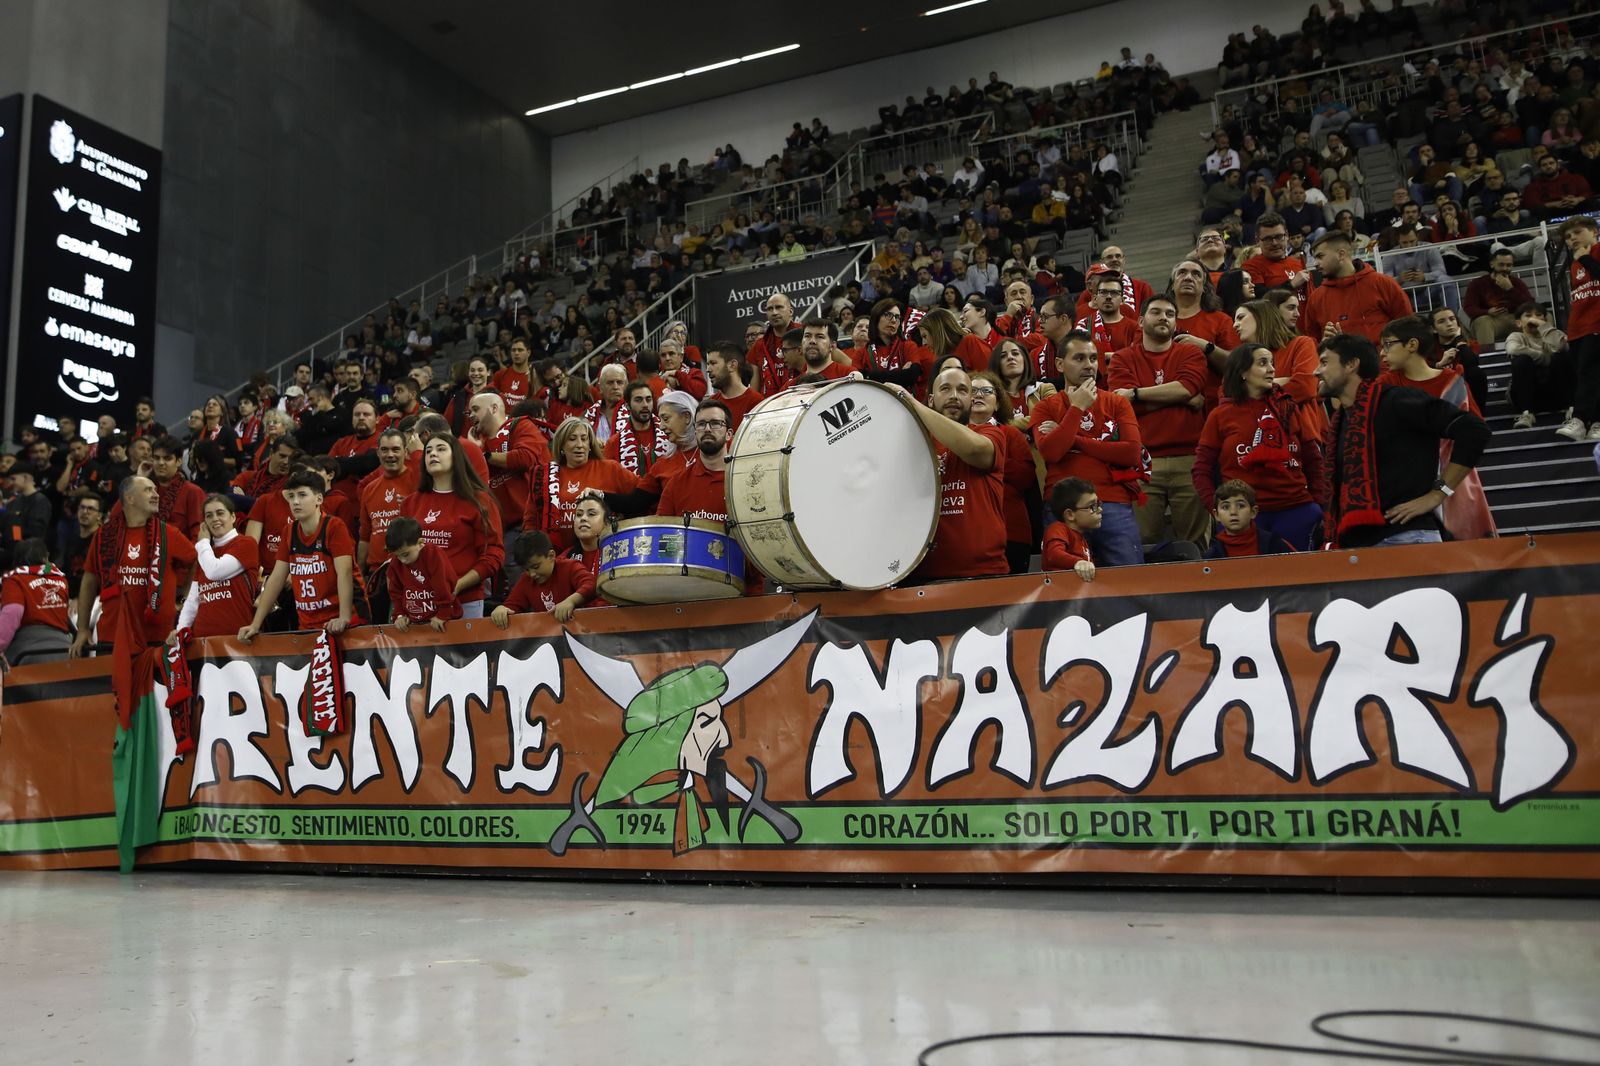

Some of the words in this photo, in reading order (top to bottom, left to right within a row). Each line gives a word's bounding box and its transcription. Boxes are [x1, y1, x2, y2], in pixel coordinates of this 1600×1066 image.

[736, 305, 754, 318] DE
[60, 323, 136, 358] emasagra
[63, 358, 115, 388] PULEVA
[817, 397, 855, 437] NP
[202, 590, 232, 603] Nueva
[155, 641, 563, 803] RENTE
[291, 813, 416, 838] SENTIMIENTO,
[420, 815, 520, 839] COLORES,
[616, 812, 667, 836] 1994
[1004, 810, 1079, 839] SOLO
[1090, 810, 1154, 838] POR
[1209, 809, 1276, 838] POR
[1284, 809, 1315, 837] TI
[1327, 801, 1463, 838] GRANÁ!
